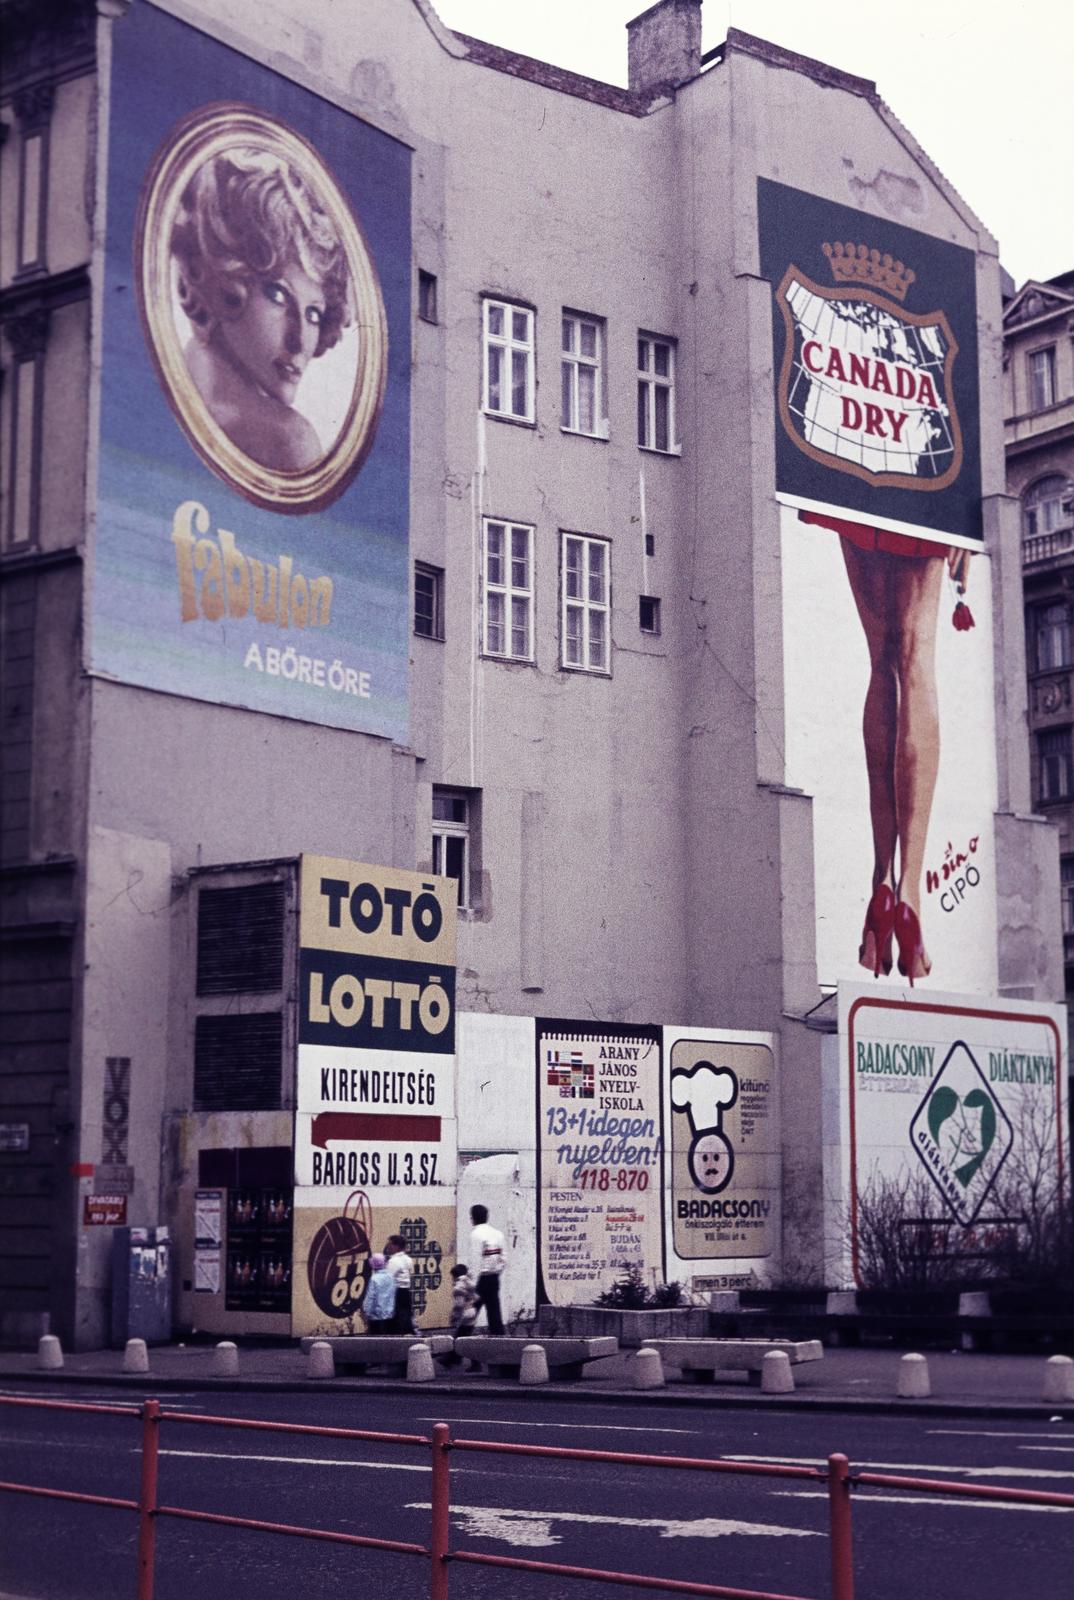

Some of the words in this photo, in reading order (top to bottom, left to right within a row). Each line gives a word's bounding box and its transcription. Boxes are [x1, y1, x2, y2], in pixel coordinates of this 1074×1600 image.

[803, 340, 938, 409] CANADA
[840, 395, 908, 443] DRY
[171, 500, 333, 629] fabulon
[599, 1046, 640, 1060] ARANY
[856, 1041, 936, 1077] BADACSONY
[989, 1048, 1055, 1085] DIÁKTANYA
[599, 1061, 637, 1077] JÁNOS
[321, 1067, 435, 1106] KIRENDELTSÉG
[600, 1080, 641, 1093] NYELV-
[600, 1097, 644, 1110] ISKOLA
[313, 1151, 380, 1186] BAROSS
[580, 1168, 648, 1191] 118-870
[550, 1192, 582, 1202] PESTEN
[677, 1199, 770, 1219] BADACSONY
[721, 1277, 729, 1287] 3
[729, 1277, 752, 1289] perc
